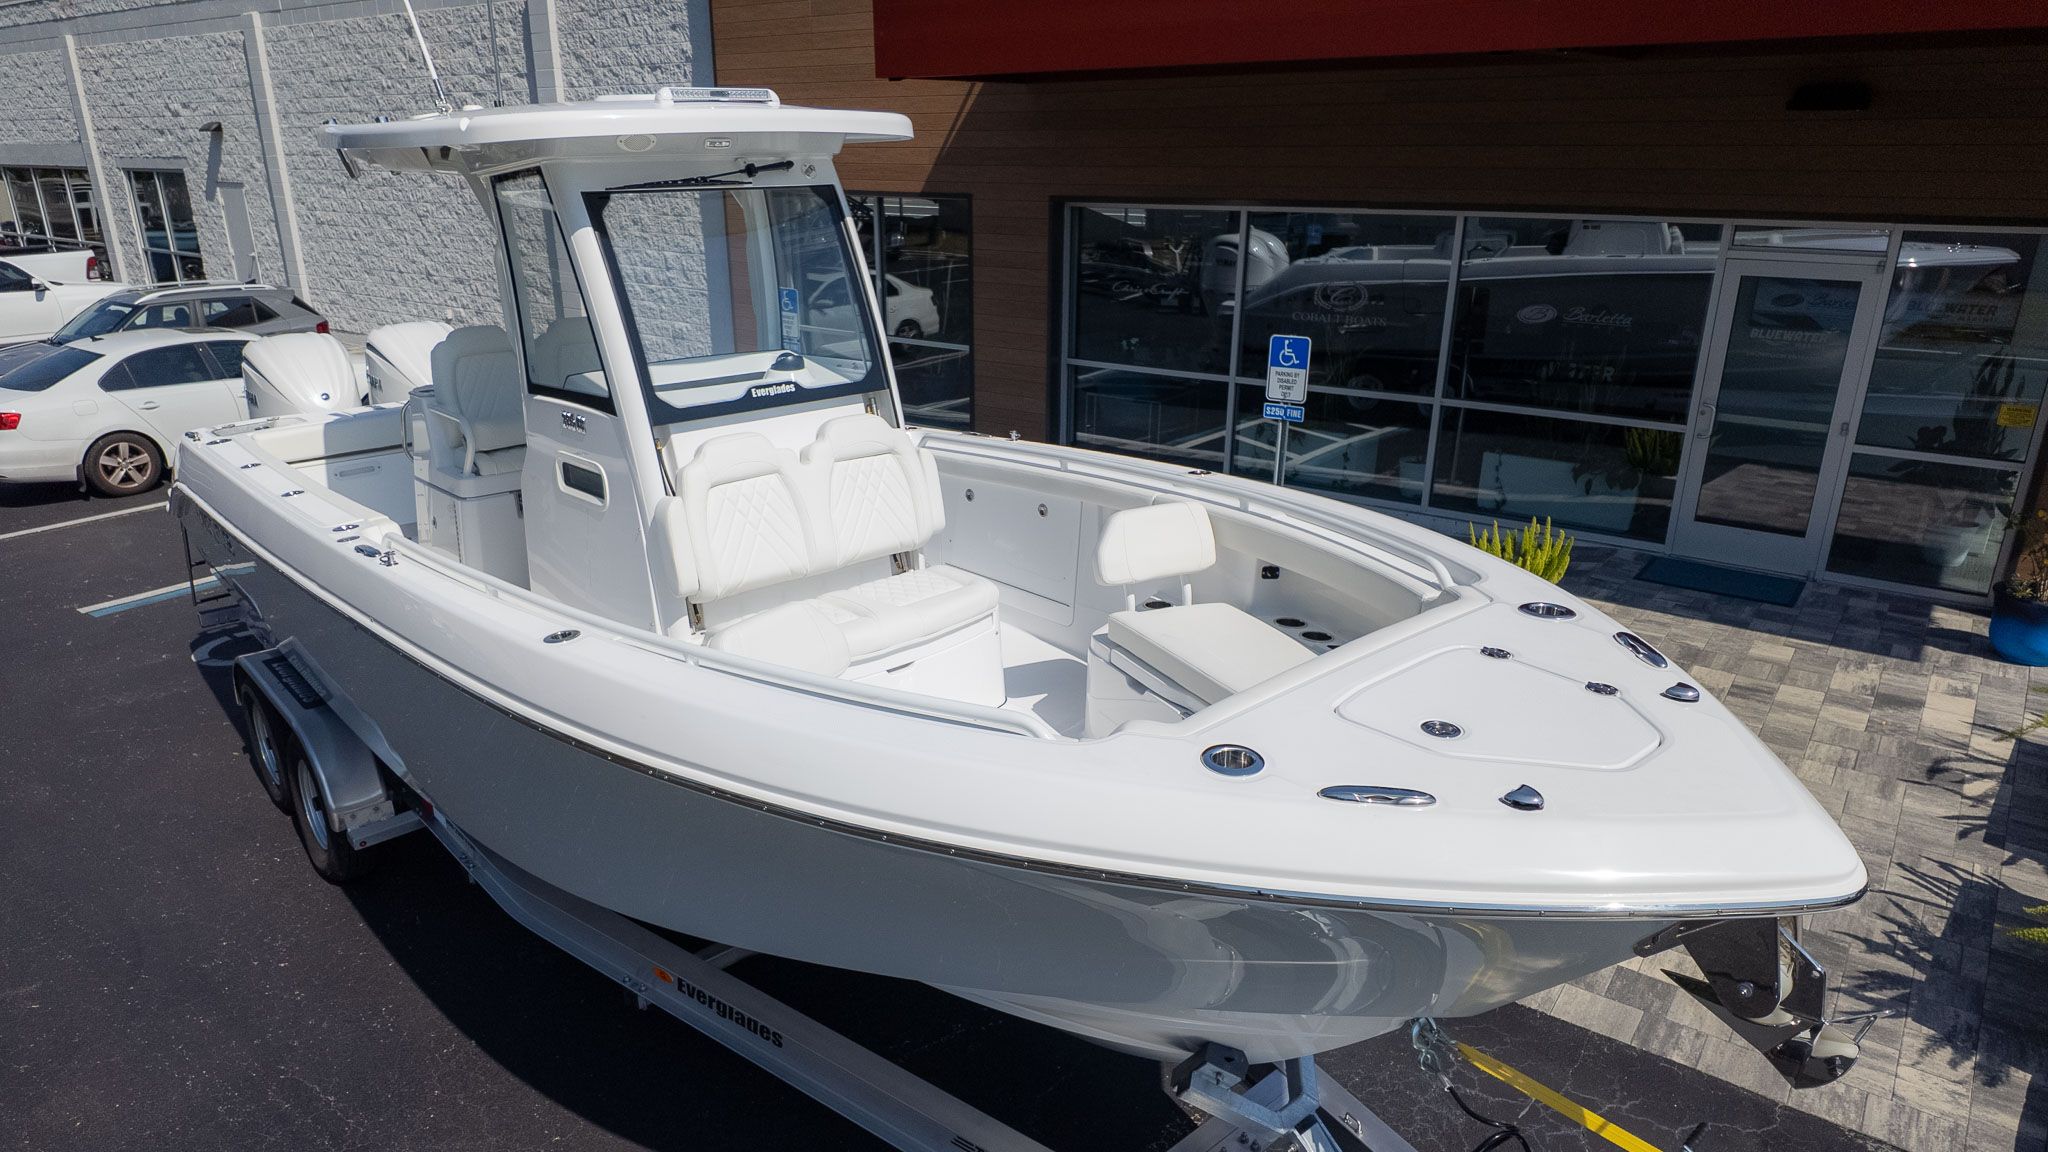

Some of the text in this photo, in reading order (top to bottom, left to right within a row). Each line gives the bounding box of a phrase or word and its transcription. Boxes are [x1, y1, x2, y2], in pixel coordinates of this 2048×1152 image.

[1275, 370, 1293, 378] PARKING
[751, 383, 796, 398] Everglades
[1286, 408, 1302, 418] FINE
[677, 977, 783, 1048] Everglades
